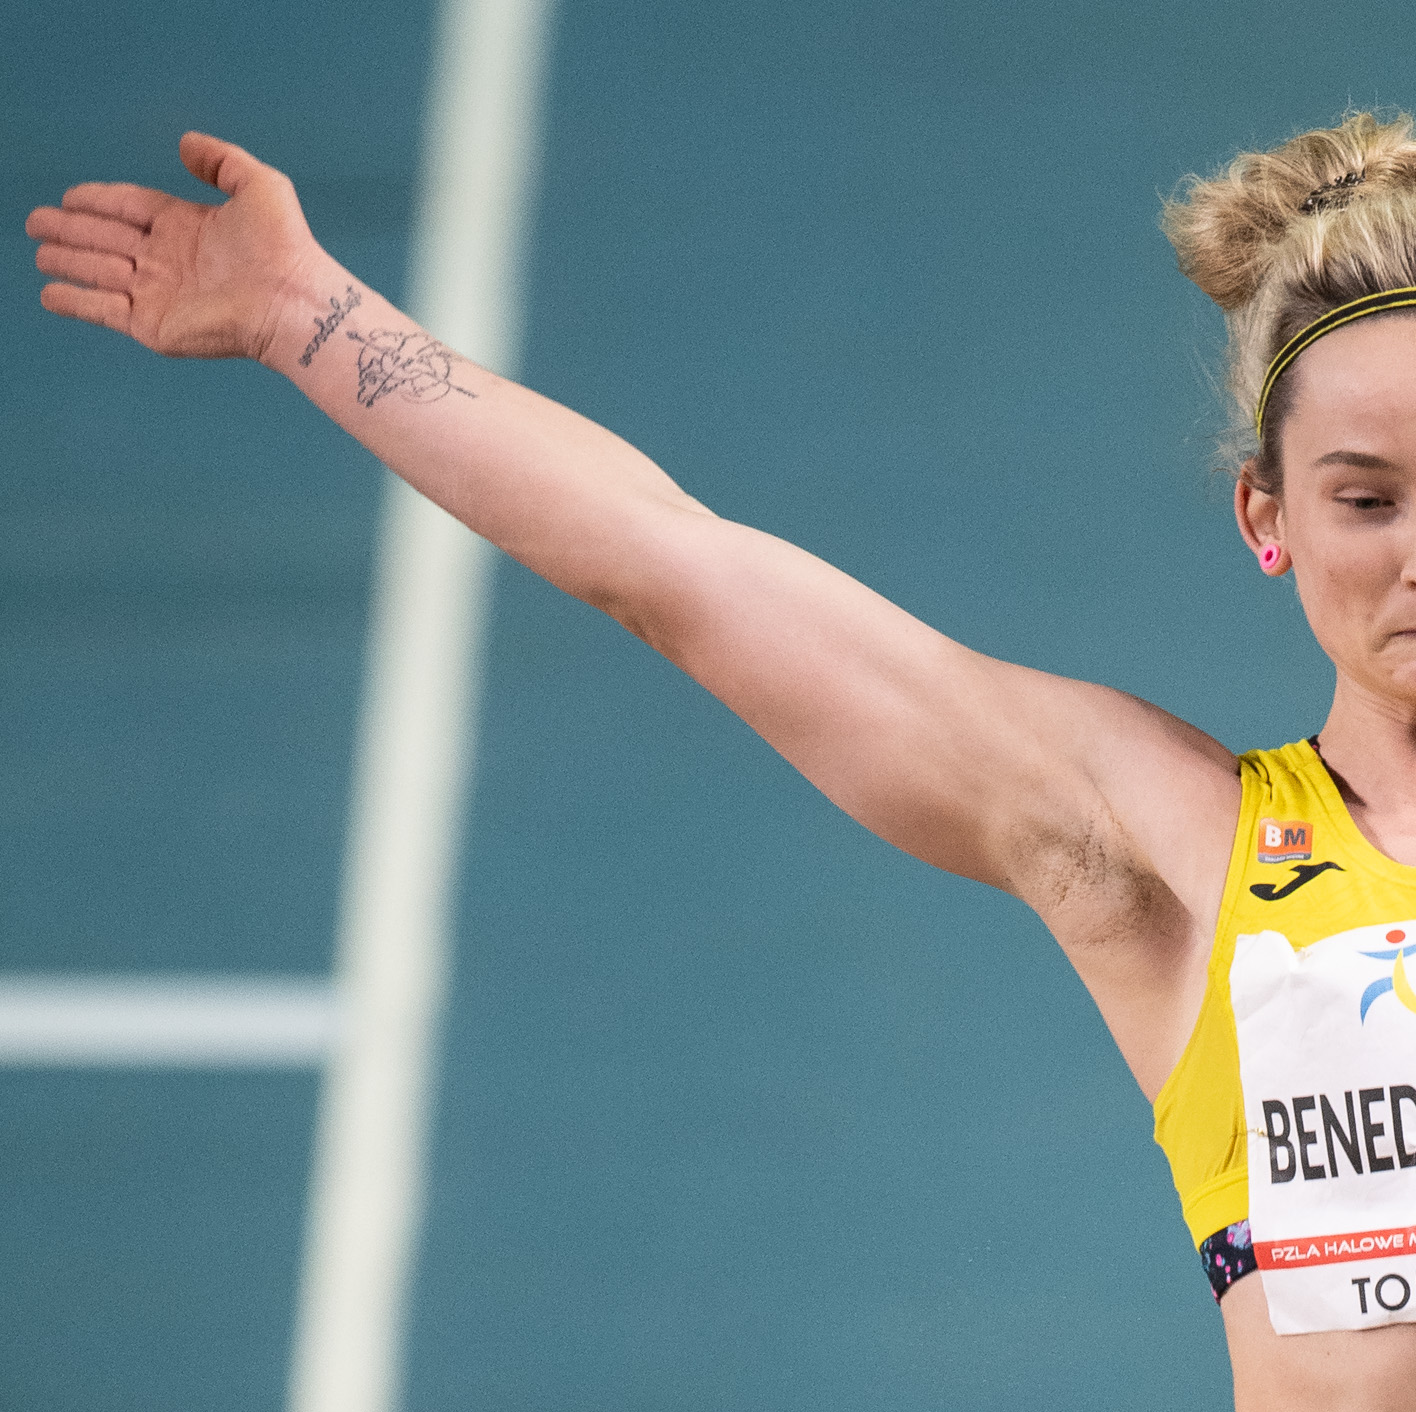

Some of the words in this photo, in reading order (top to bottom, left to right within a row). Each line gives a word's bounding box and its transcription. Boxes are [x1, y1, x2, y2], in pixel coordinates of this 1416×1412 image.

[1264, 824, 1307, 848] BM
[1271, 1243, 1321, 1263] PZLA
[1324, 1233, 1404, 1256] HALOWE
